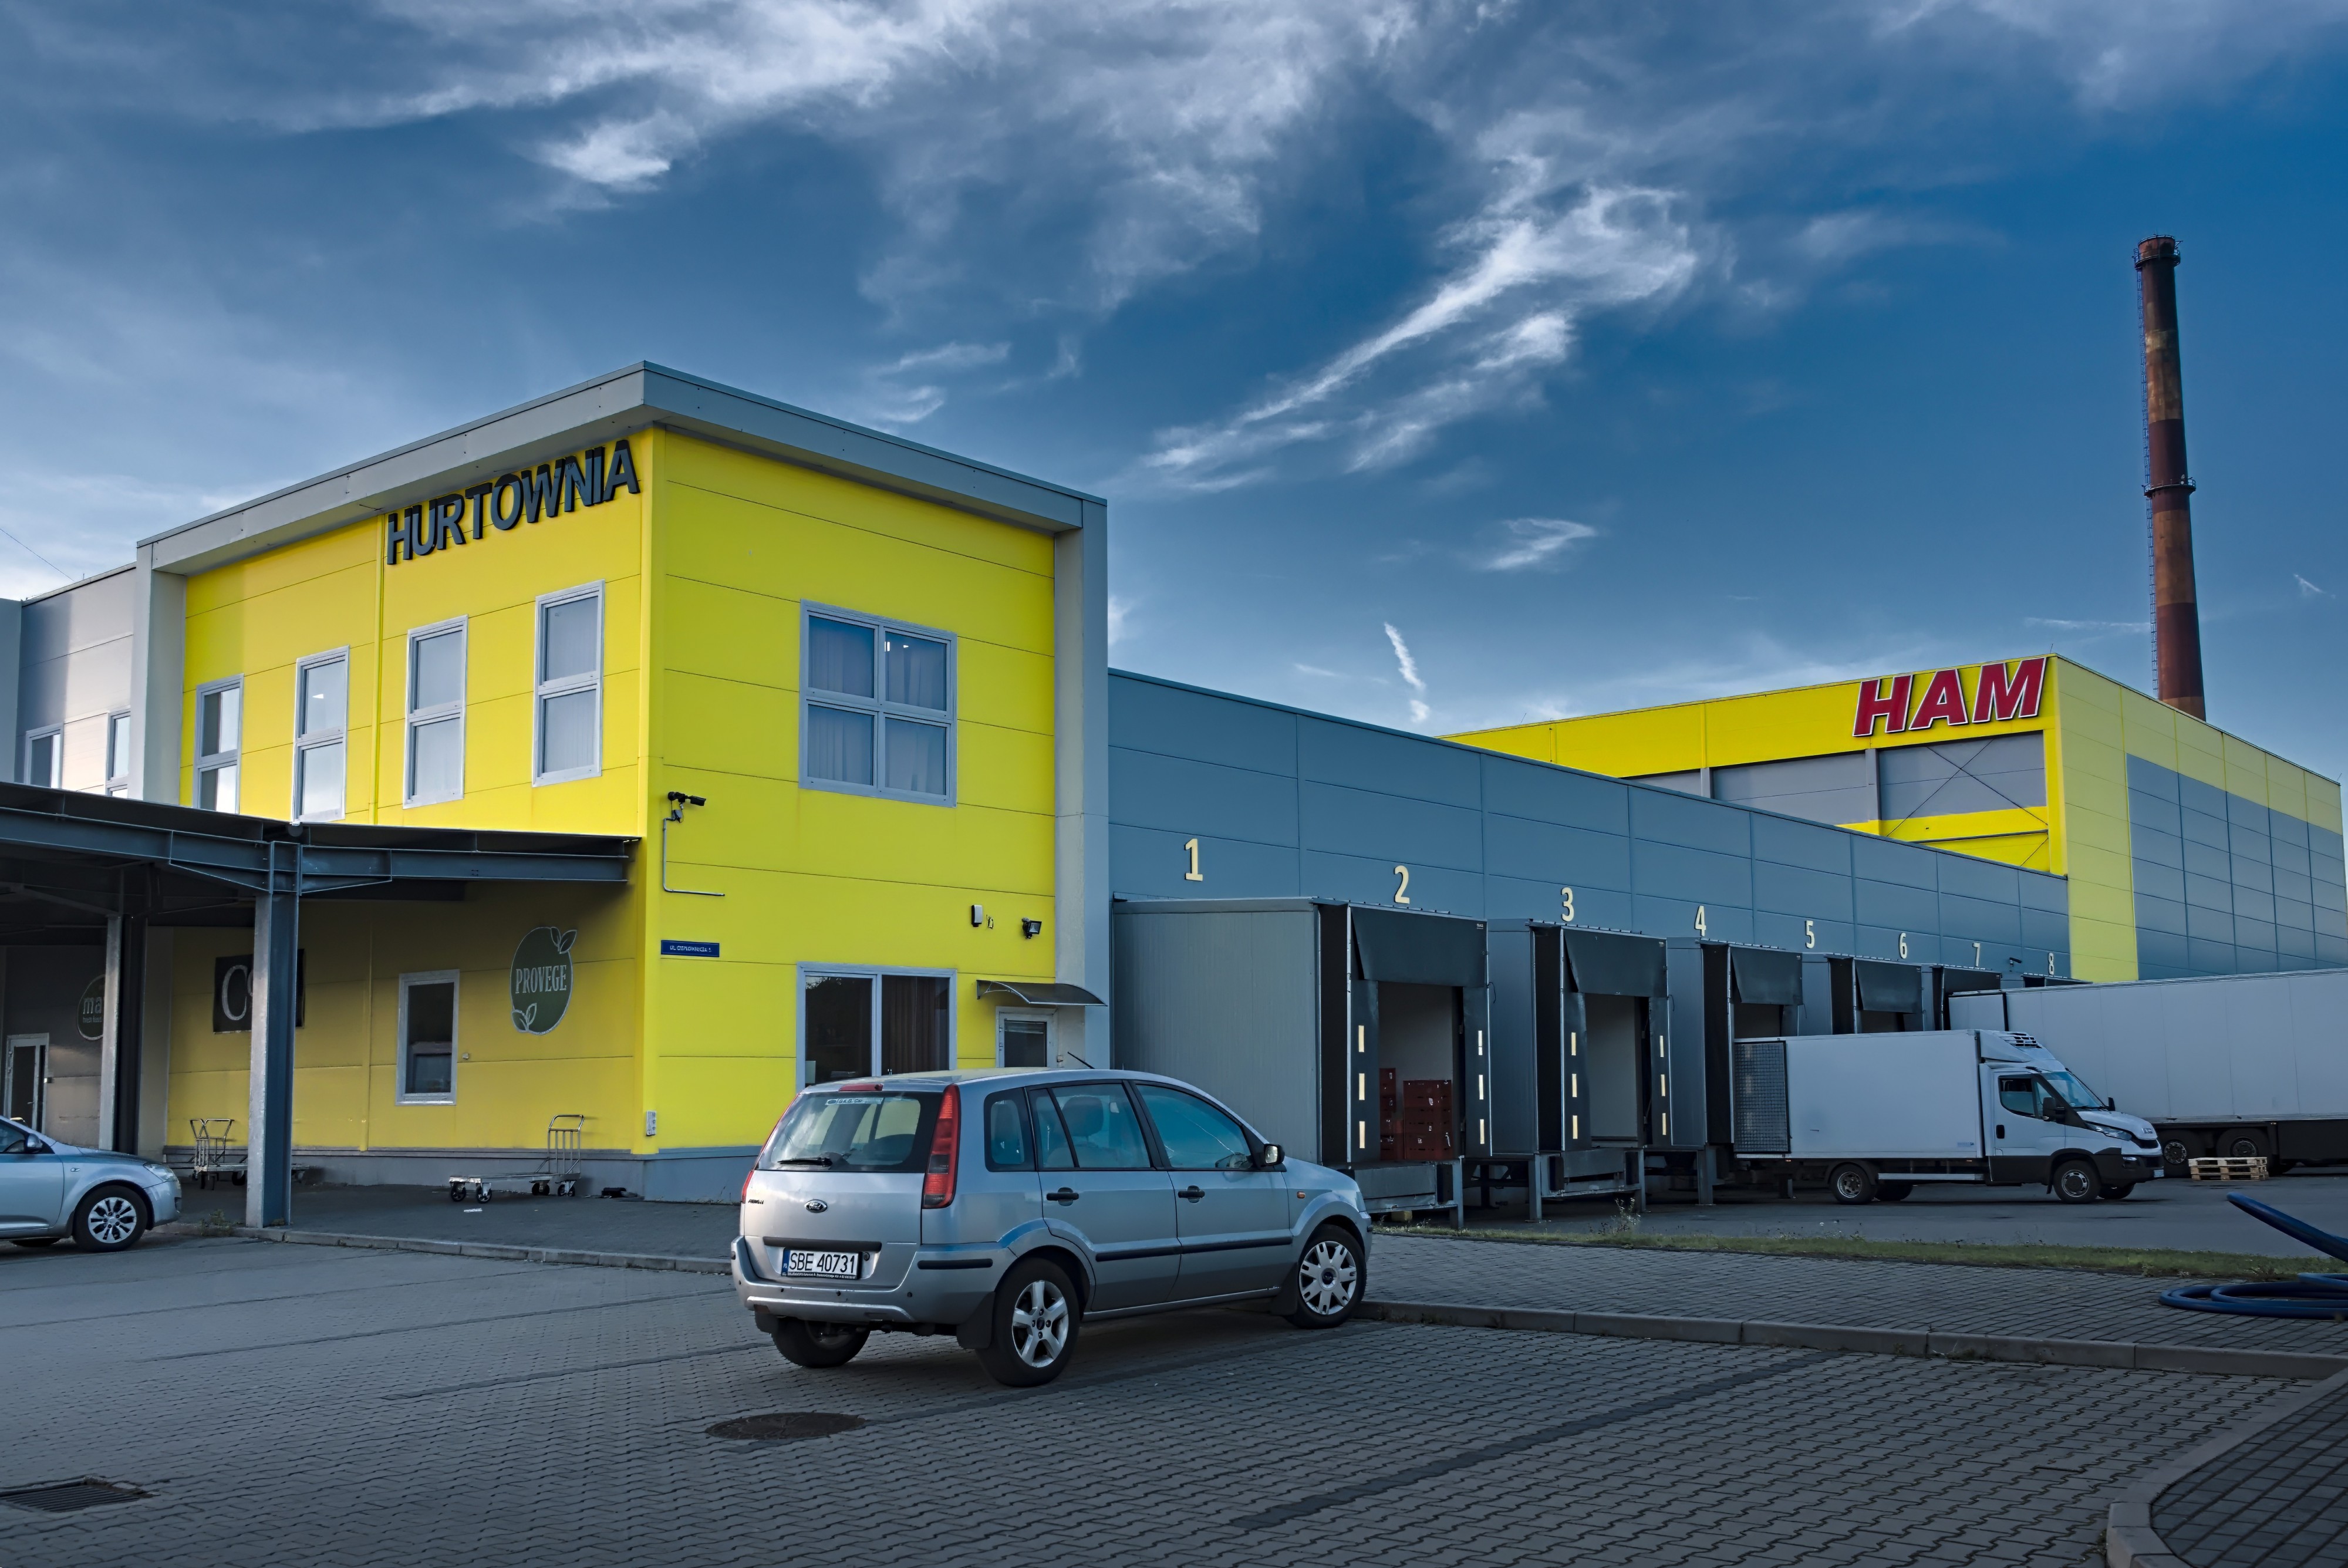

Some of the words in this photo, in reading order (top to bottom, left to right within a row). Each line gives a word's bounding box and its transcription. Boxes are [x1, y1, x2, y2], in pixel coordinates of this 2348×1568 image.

[387, 440, 640, 565] HURTOWNIA
[1853, 657, 2047, 737] HAM
[1185, 838, 1203, 881] 1
[1394, 865, 1410, 904] 2
[1561, 887, 1574, 922] 3
[1695, 905, 1706, 936] 4
[1804, 920, 1815, 949] 5
[1898, 932, 1907, 959] 6
[1972, 942, 1981, 967] 7
[2048, 952, 2054, 976] 8
[515, 965, 566, 993] PROVEGE
[83, 997, 104, 1014] ma
[789, 1252, 814, 1271] SBE
[817, 1253, 855, 1273] 40731
